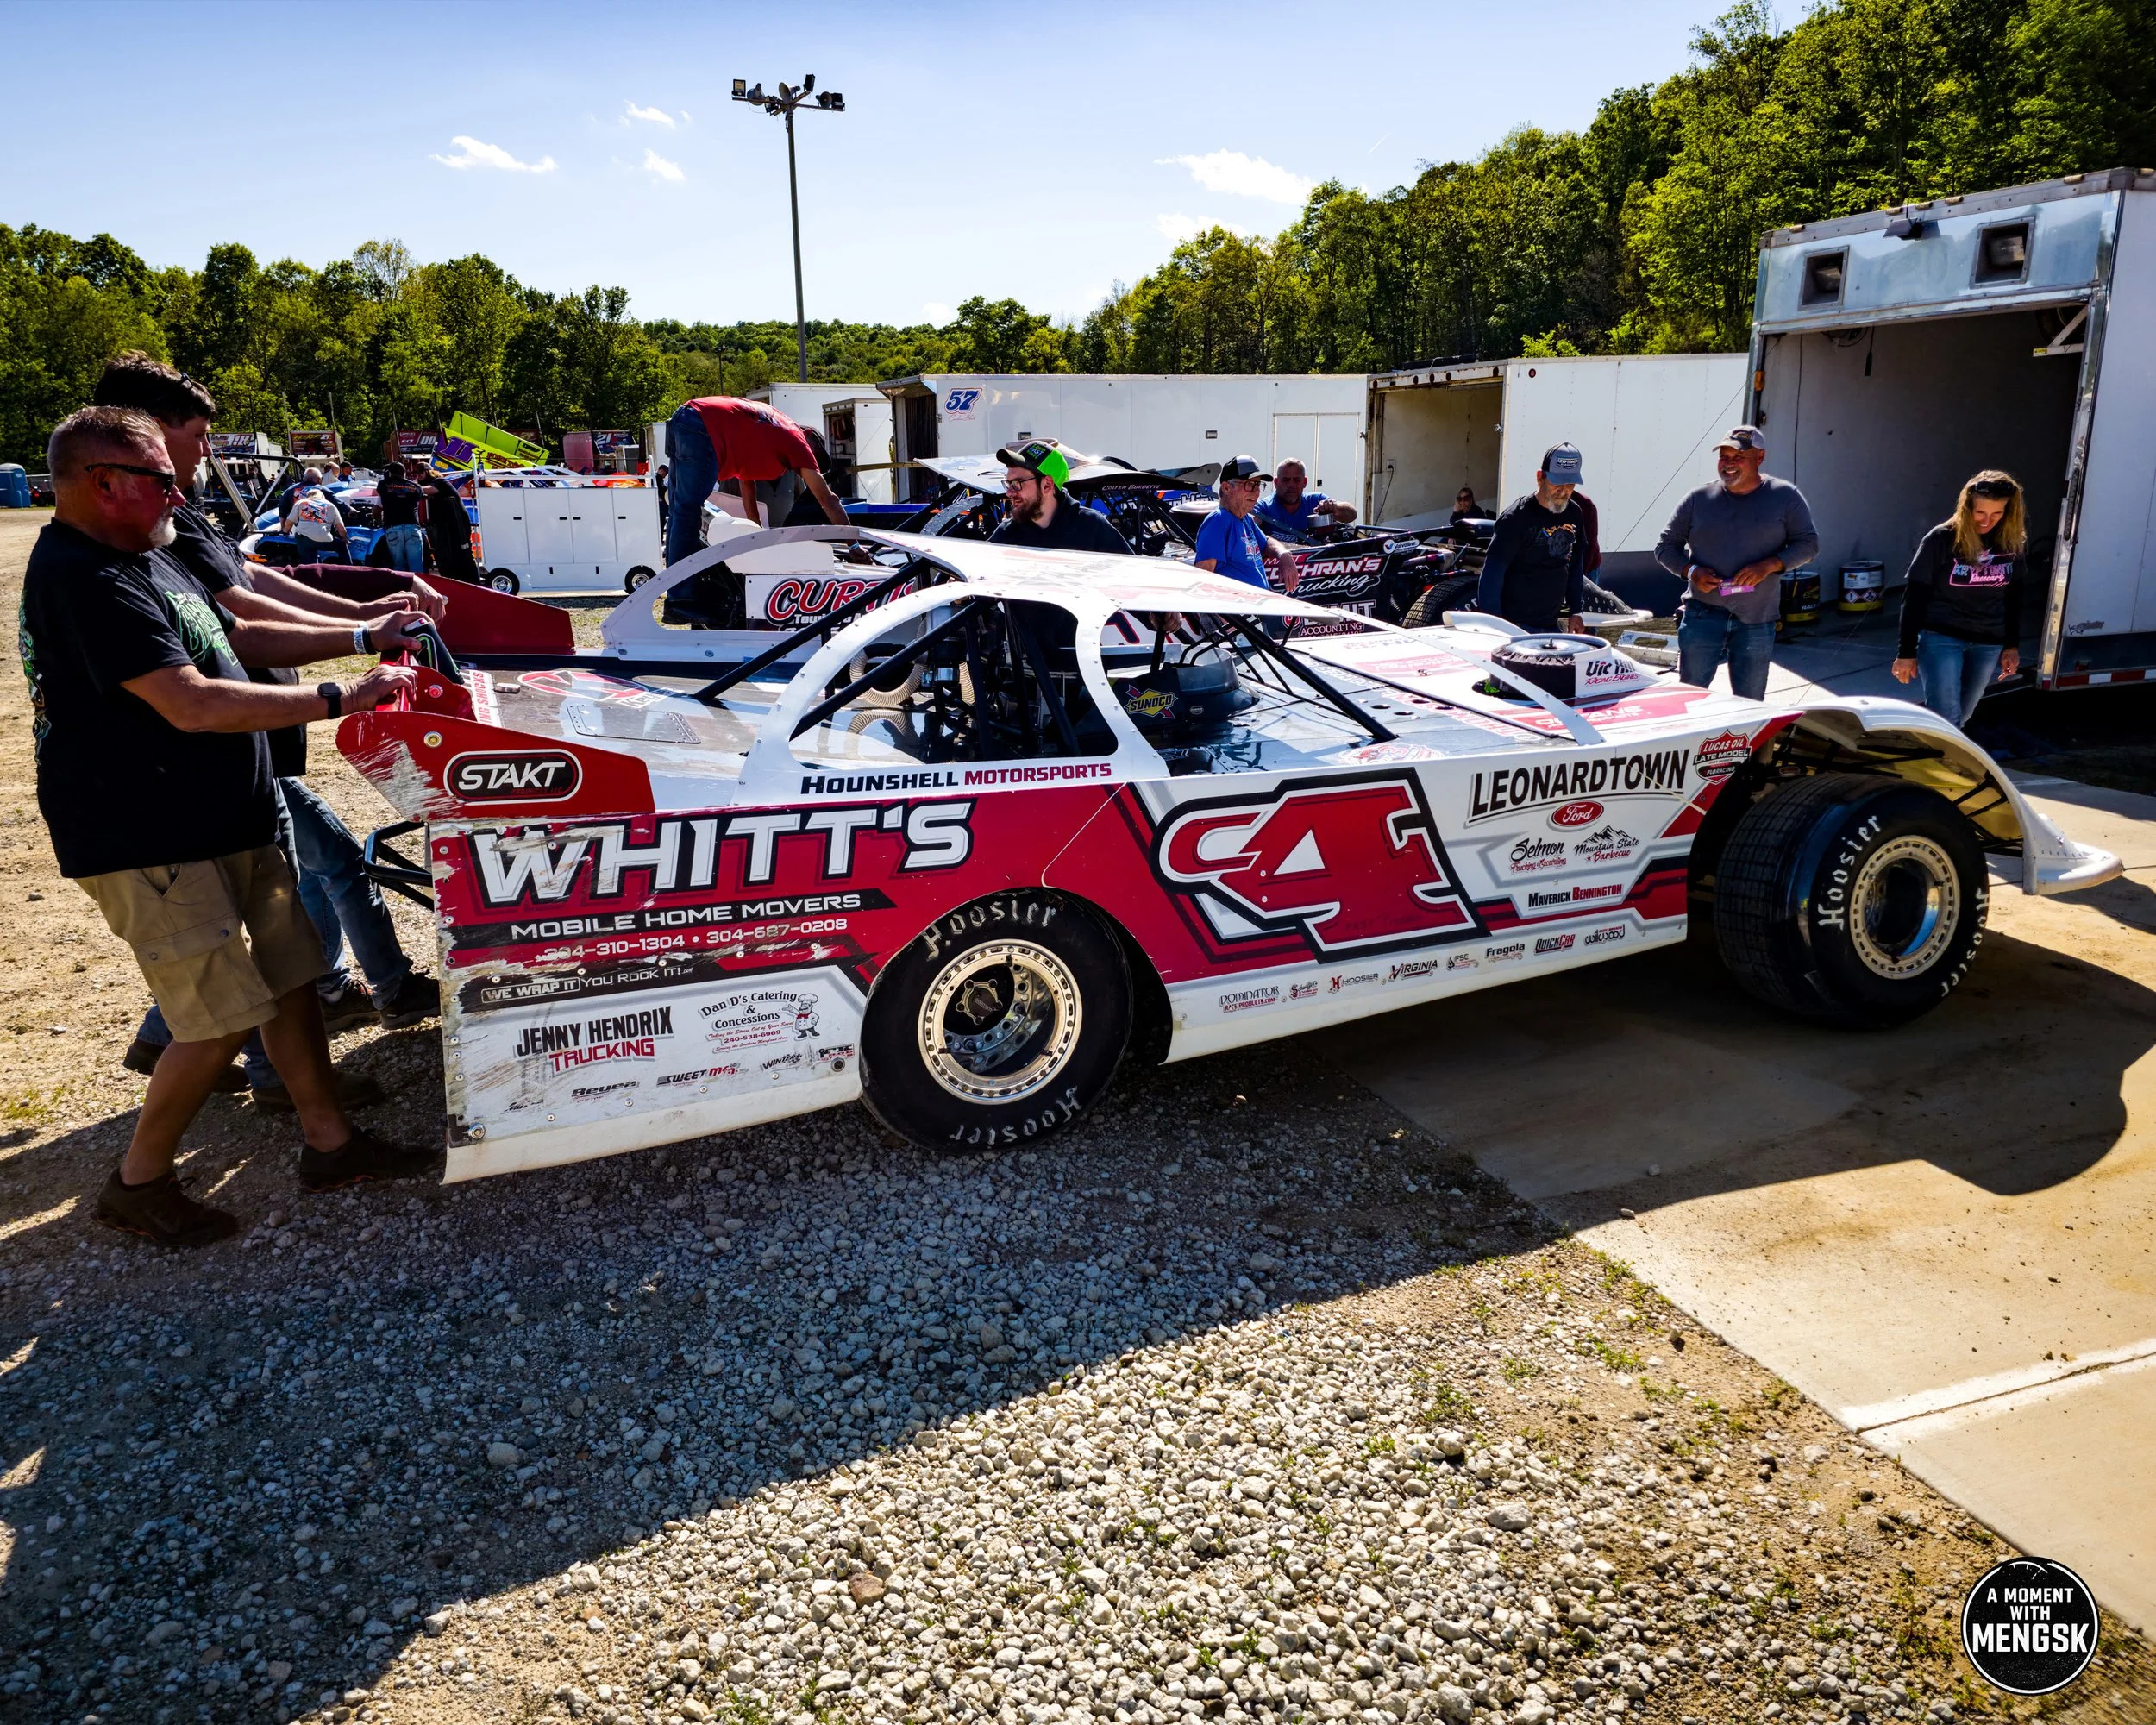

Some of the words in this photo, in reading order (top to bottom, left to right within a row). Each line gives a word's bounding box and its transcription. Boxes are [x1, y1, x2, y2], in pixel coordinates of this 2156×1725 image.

[946, 390, 981, 412] 57
[1300, 622, 1363, 637] ACCOUNTING
[1585, 660, 1613, 677] Vic
[473, 671, 490, 706] SHOCKS
[1130, 693, 1174, 712] SUNOCO
[1695, 754, 1717, 763] LATE
[1718, 749, 1748, 758] MODEL
[1703, 740, 1731, 752] LUCAS
[1731, 737, 1745, 749] OIL
[458, 762, 566, 790] STAKT
[800, 771, 959, 794] HOUNSHELL
[964, 762, 1112, 786] MOTORSPORTS
[1471, 749, 1690, 817] LEONARDTOWN
[1562, 804, 1595, 823] Ford
[472, 801, 974, 904] WHITT'S
[1510, 837, 1565, 862] Selmon
[1574, 843, 1614, 856] Mountain
[1616, 837, 1639, 849] State
[1593, 849, 1631, 862] Barbecue
[1817, 814, 1883, 932] Hoosier
[1527, 891, 1571, 908] MAVERICK
[1572, 883, 1622, 901] BENNINGTON
[511, 913, 636, 941] MOBILE
[645, 905, 732, 928] HOME
[741, 894, 861, 919] MOVERS
[706, 918, 848, 944] 304-687-0208
[924, 897, 1057, 963] Hoosier
[1584, 924, 1626, 944] wilwood
[1486, 942, 1526, 957] Fragola
[1389, 959, 1438, 980] VIRGINIA
[486, 988, 512, 1000] WE
[517, 982, 560, 997] WRAP
[564, 979, 577, 990] IT
[581, 976, 613, 988] YOU
[617, 971, 659, 983] ROCK
[664, 967, 681, 976] IT!
[1219, 985, 1280, 1005] DOMINATOR
[1342, 973, 1379, 984] HOOSIER
[700, 1000, 727, 1016] Dan
[730, 994, 749, 1007] D's
[750, 991, 798, 1003] Catering
[746, 1004, 756, 1015] &
[517, 1023, 581, 1057] JENNY
[588, 1005, 674, 1044] HENDRIX
[714, 1011, 780, 1030] Concessions
[724, 1029, 781, 1044] 240-538-6969
[548, 1038, 655, 1072] TRUCKING
[665, 1069, 707, 1084] SWEET
